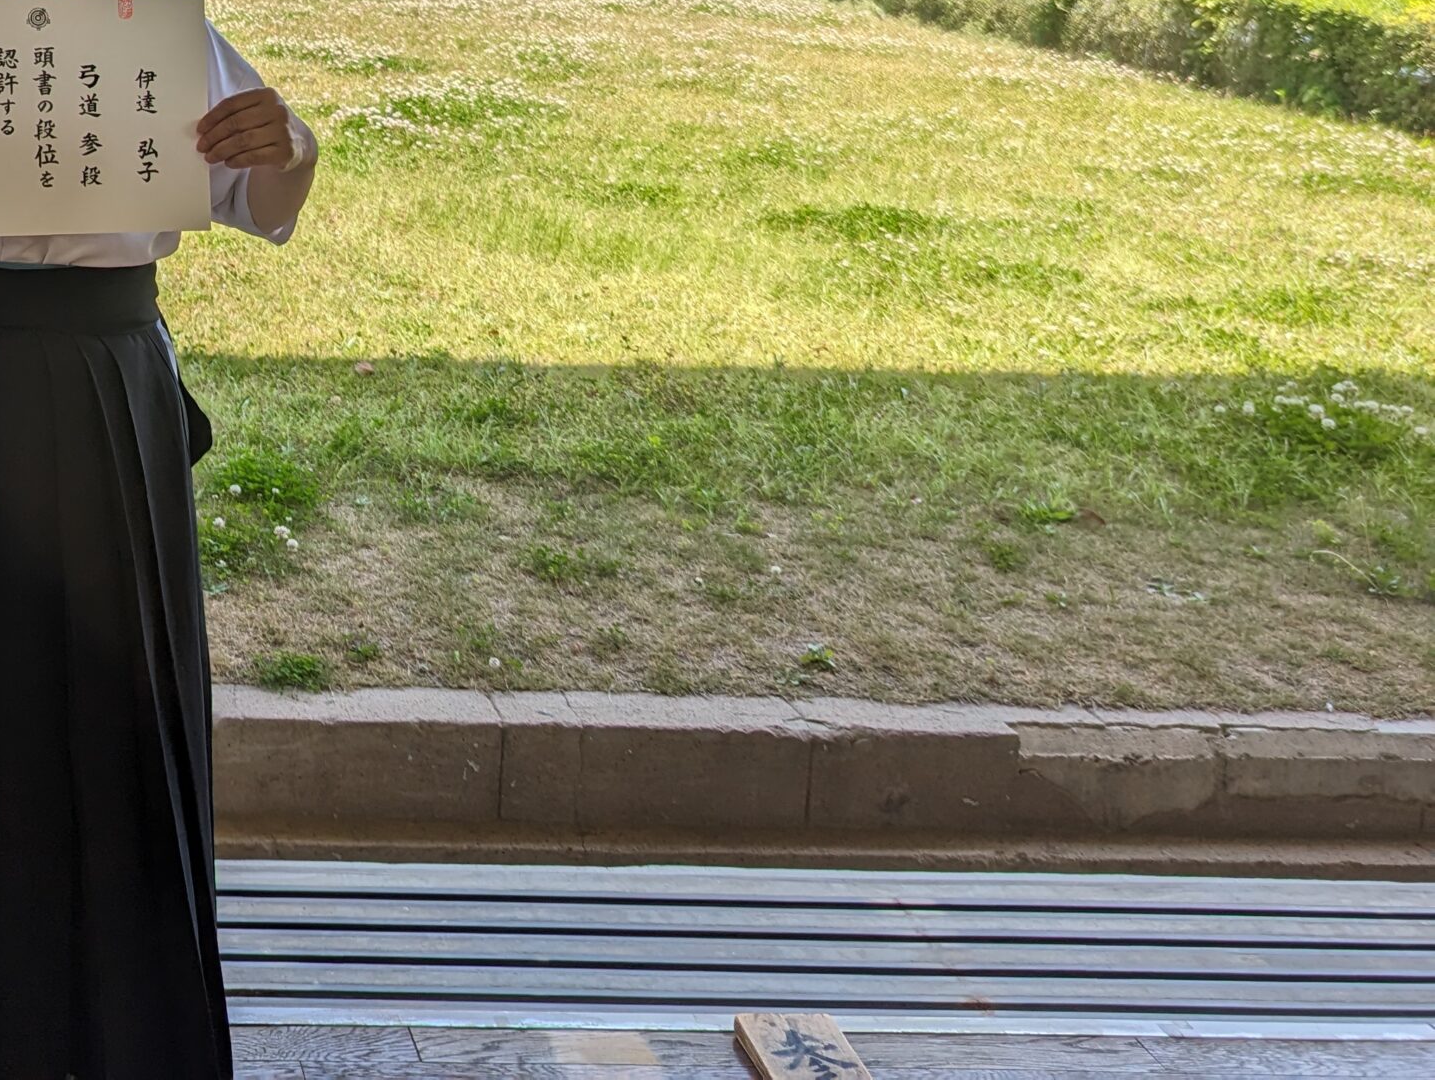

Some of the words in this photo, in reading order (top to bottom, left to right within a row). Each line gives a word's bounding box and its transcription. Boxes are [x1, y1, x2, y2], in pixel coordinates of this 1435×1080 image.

[135, 69, 158, 114] 伊達
[32, 46, 60, 189] 頭書の段位を
[136, 138, 160, 184] 弘子
